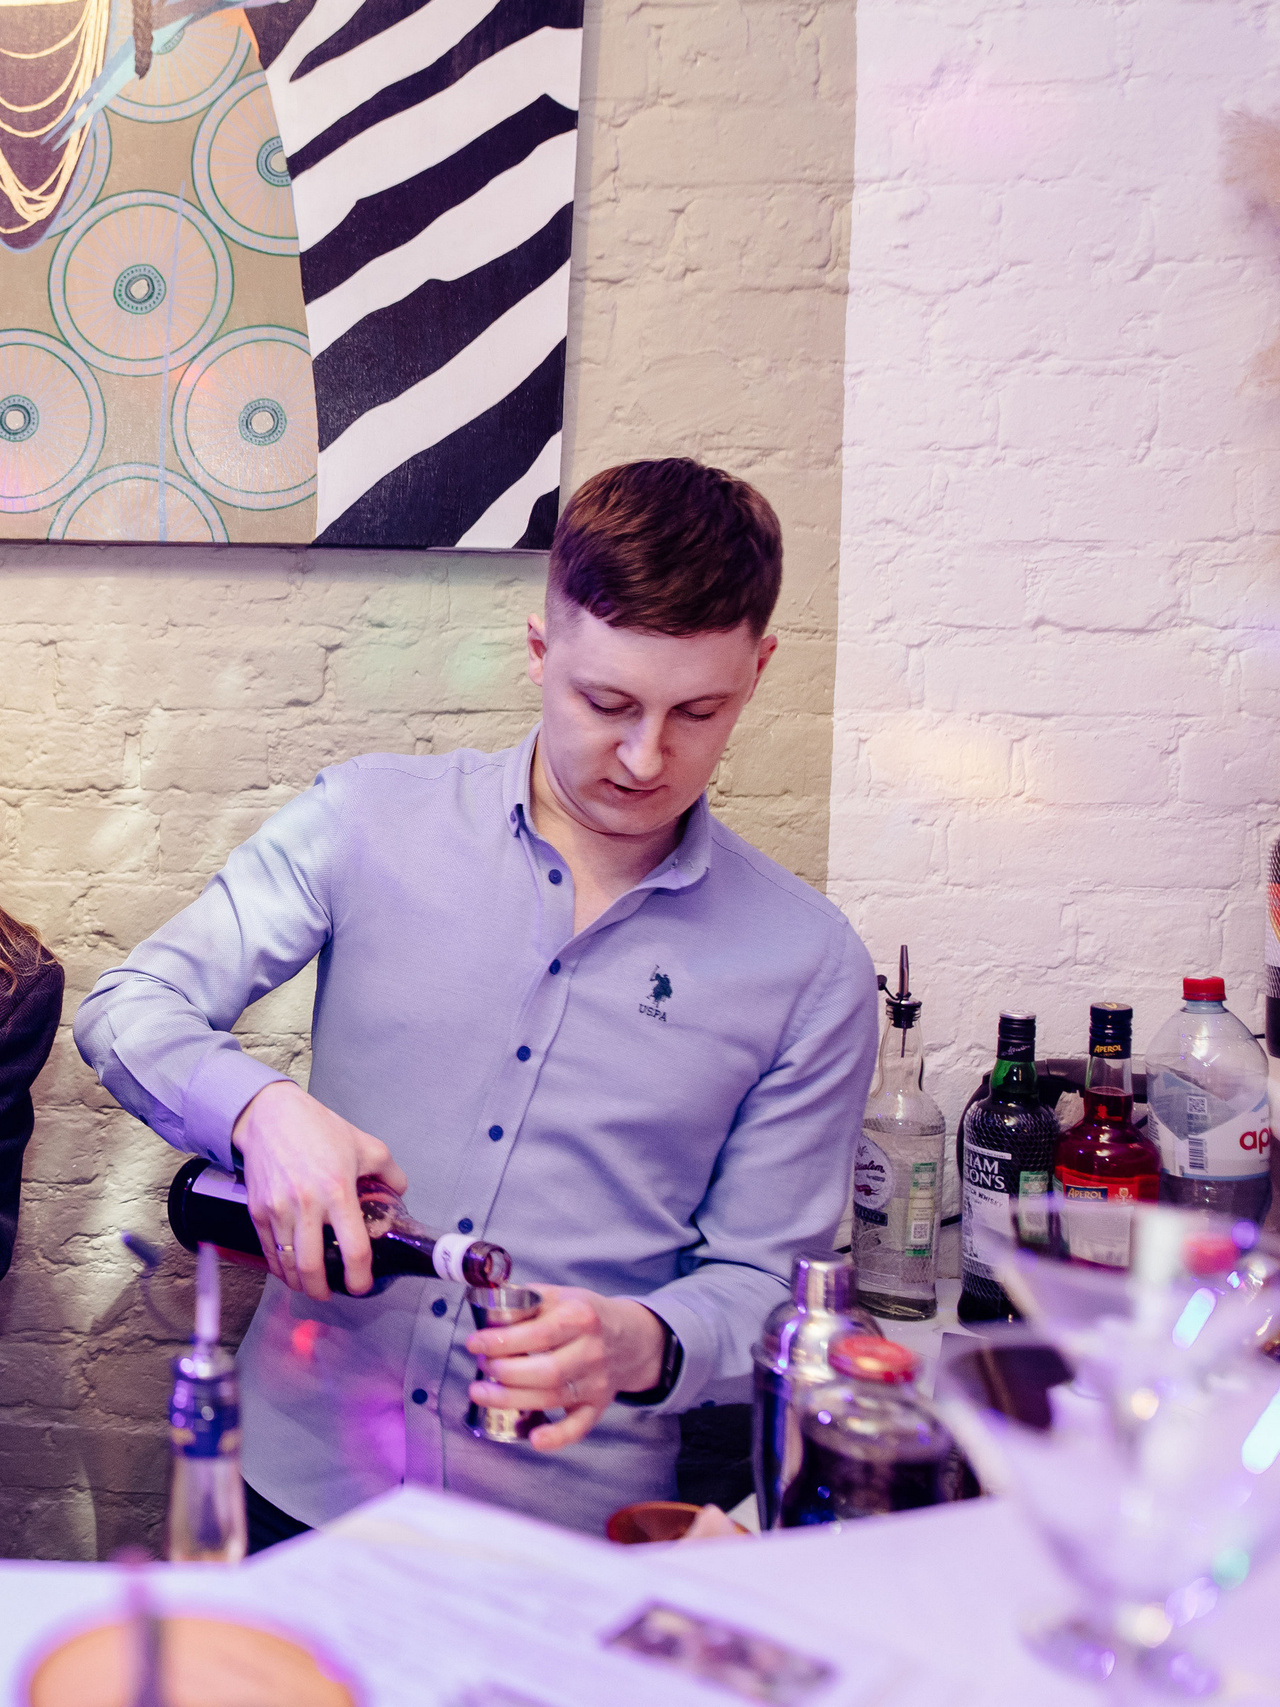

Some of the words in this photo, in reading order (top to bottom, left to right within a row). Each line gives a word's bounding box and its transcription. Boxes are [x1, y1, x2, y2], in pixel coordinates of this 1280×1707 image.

[639, 1003, 667, 1022] USPA
[1094, 1044, 1123, 1054] APEROL
[1067, 1187, 1104, 1200] APEROL
